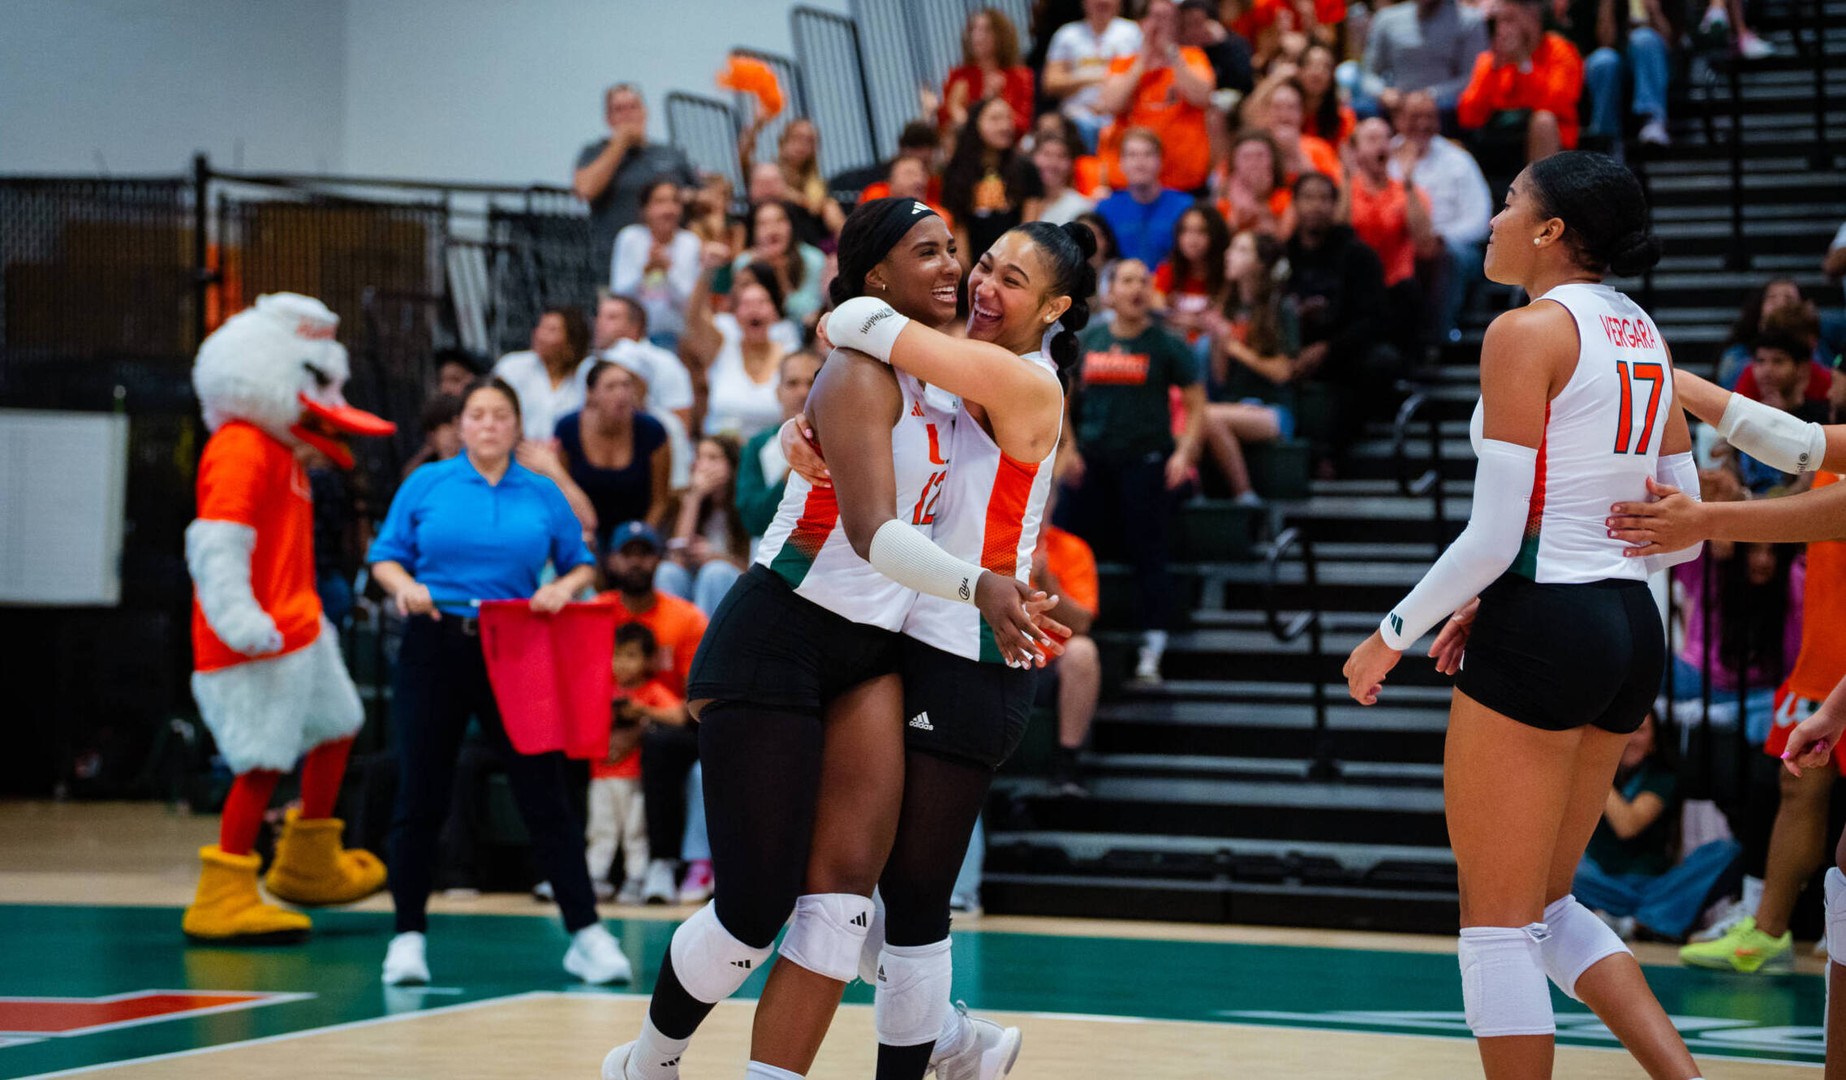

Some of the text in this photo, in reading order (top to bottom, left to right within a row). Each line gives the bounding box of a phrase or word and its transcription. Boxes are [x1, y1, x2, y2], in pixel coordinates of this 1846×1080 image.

[1599, 314, 1658, 349] VERGARA
[1614, 360, 1664, 455] 17
[912, 470, 947, 525] 12
[909, 721, 934, 731] adidas
